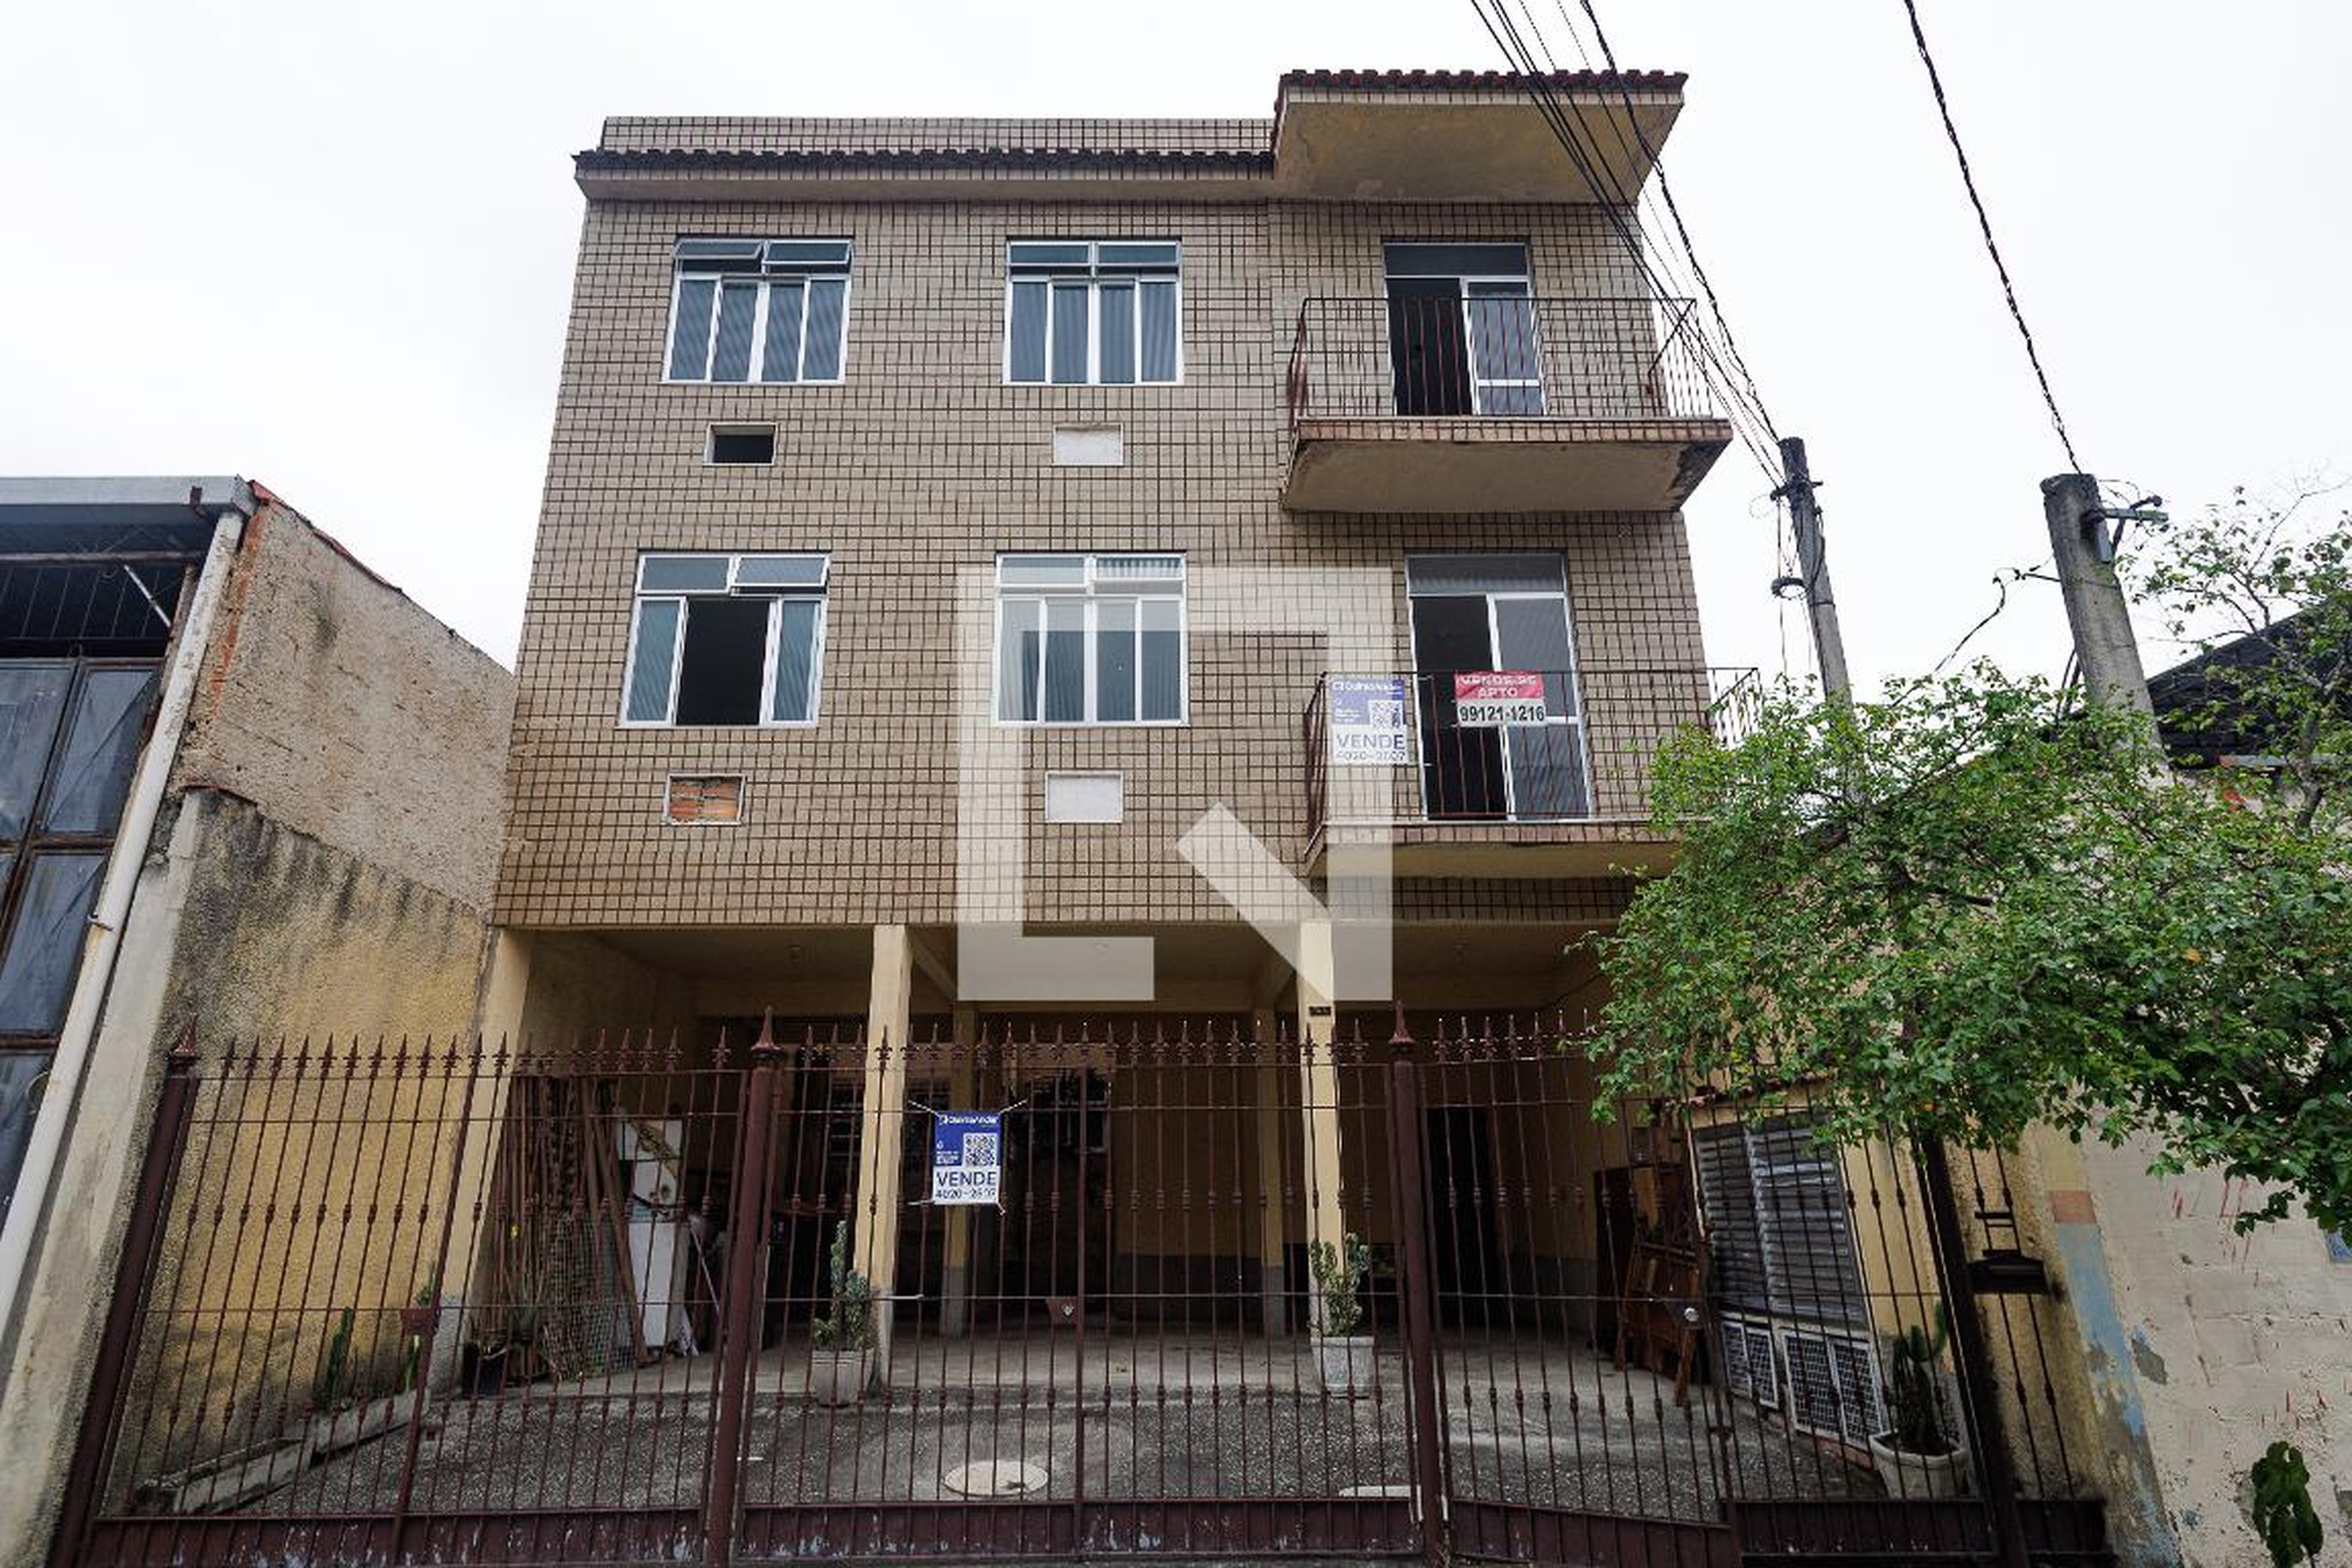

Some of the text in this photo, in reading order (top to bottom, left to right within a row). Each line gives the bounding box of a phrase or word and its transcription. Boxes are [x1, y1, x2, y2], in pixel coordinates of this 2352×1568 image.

[1478, 687, 1518, 697] APTO
[1460, 705, 1544, 721] 99121-1216
[1337, 734, 1404, 749] VENDE
[937, 1172, 997, 1186] VENDE
